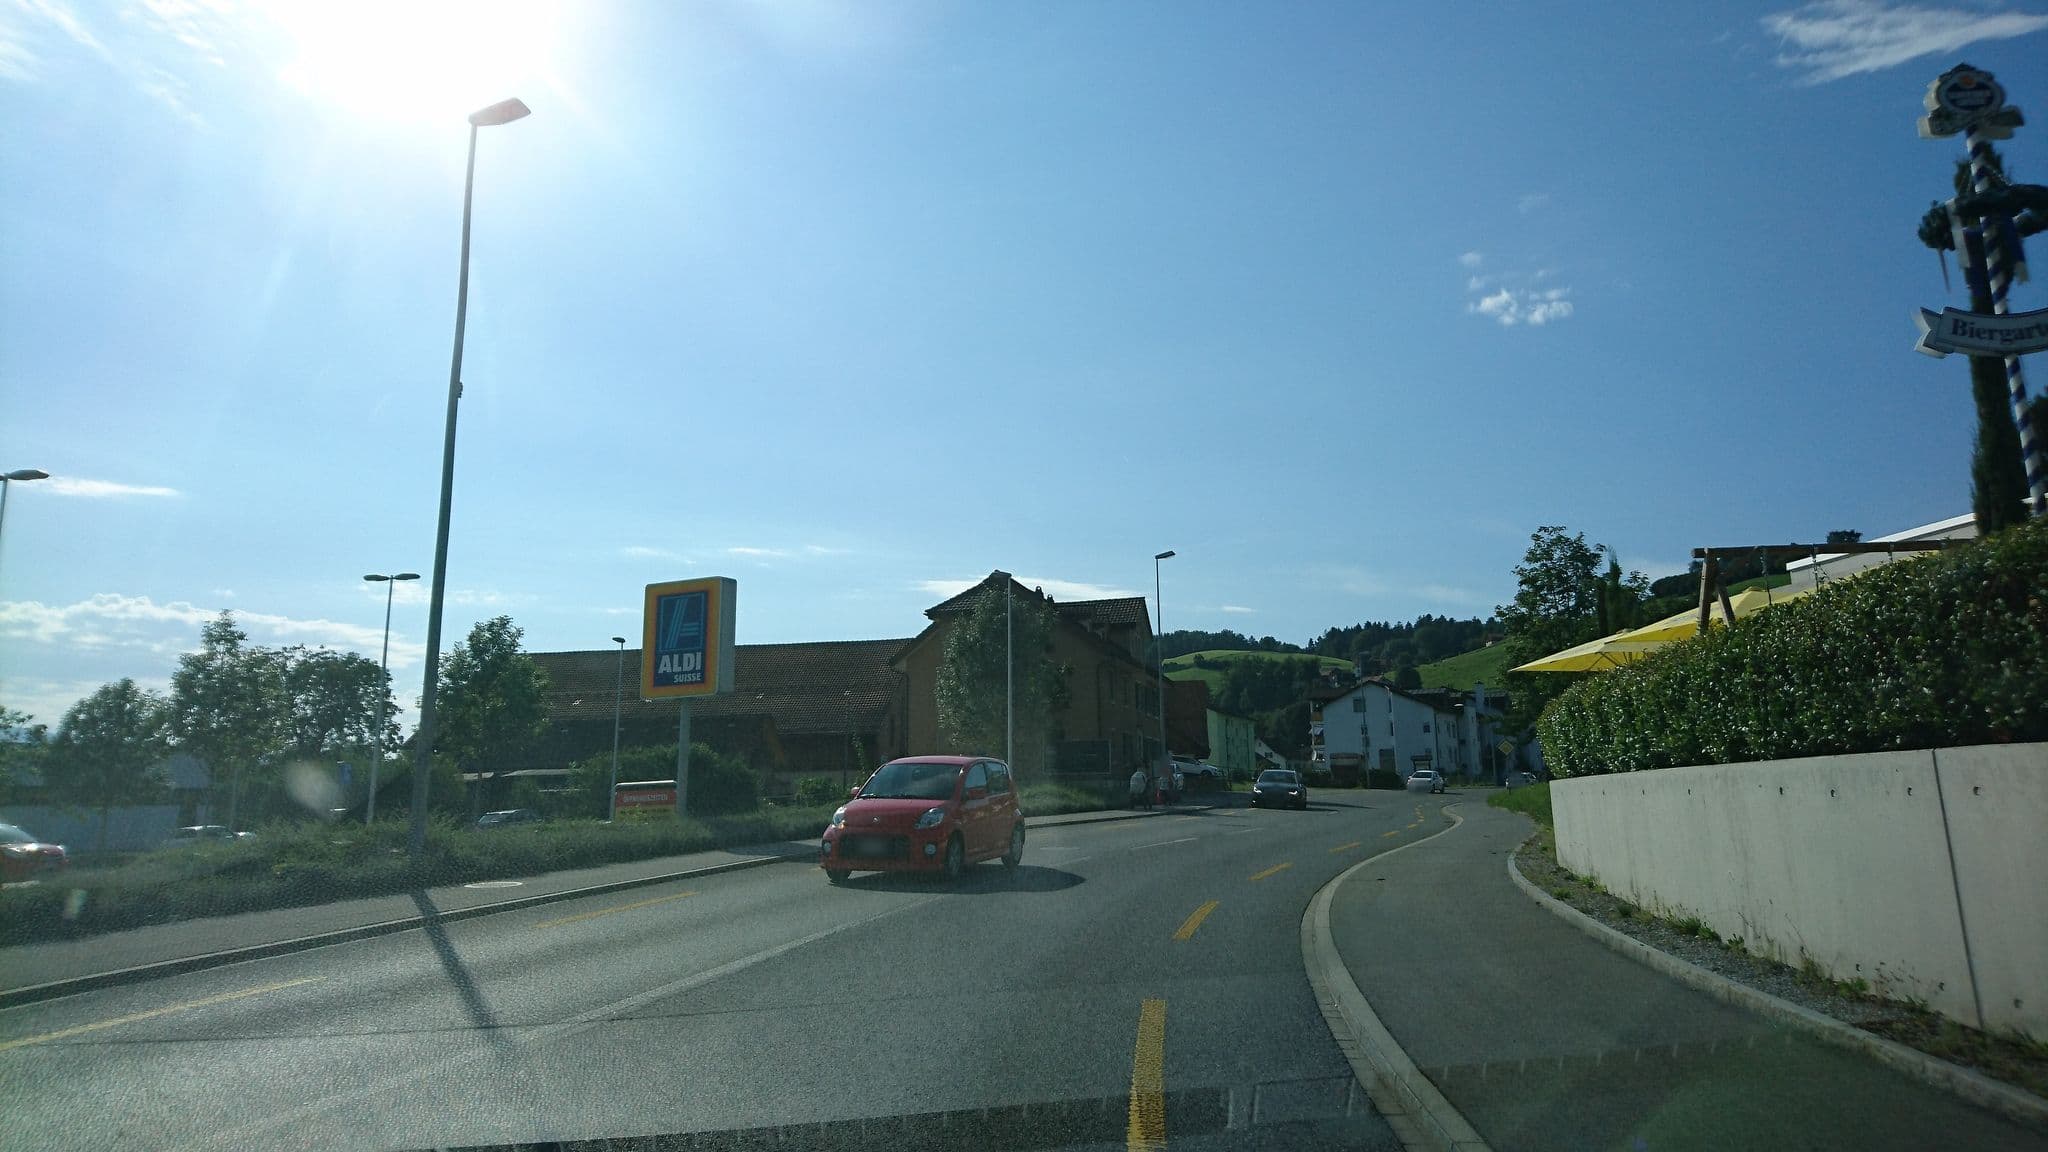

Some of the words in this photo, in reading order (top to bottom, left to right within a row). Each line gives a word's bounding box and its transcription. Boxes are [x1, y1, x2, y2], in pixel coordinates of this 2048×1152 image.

[1952, 318, 2048, 345] Biergart
[658, 652, 702, 674] ALDI
[673, 672, 702, 683] SUISSE
